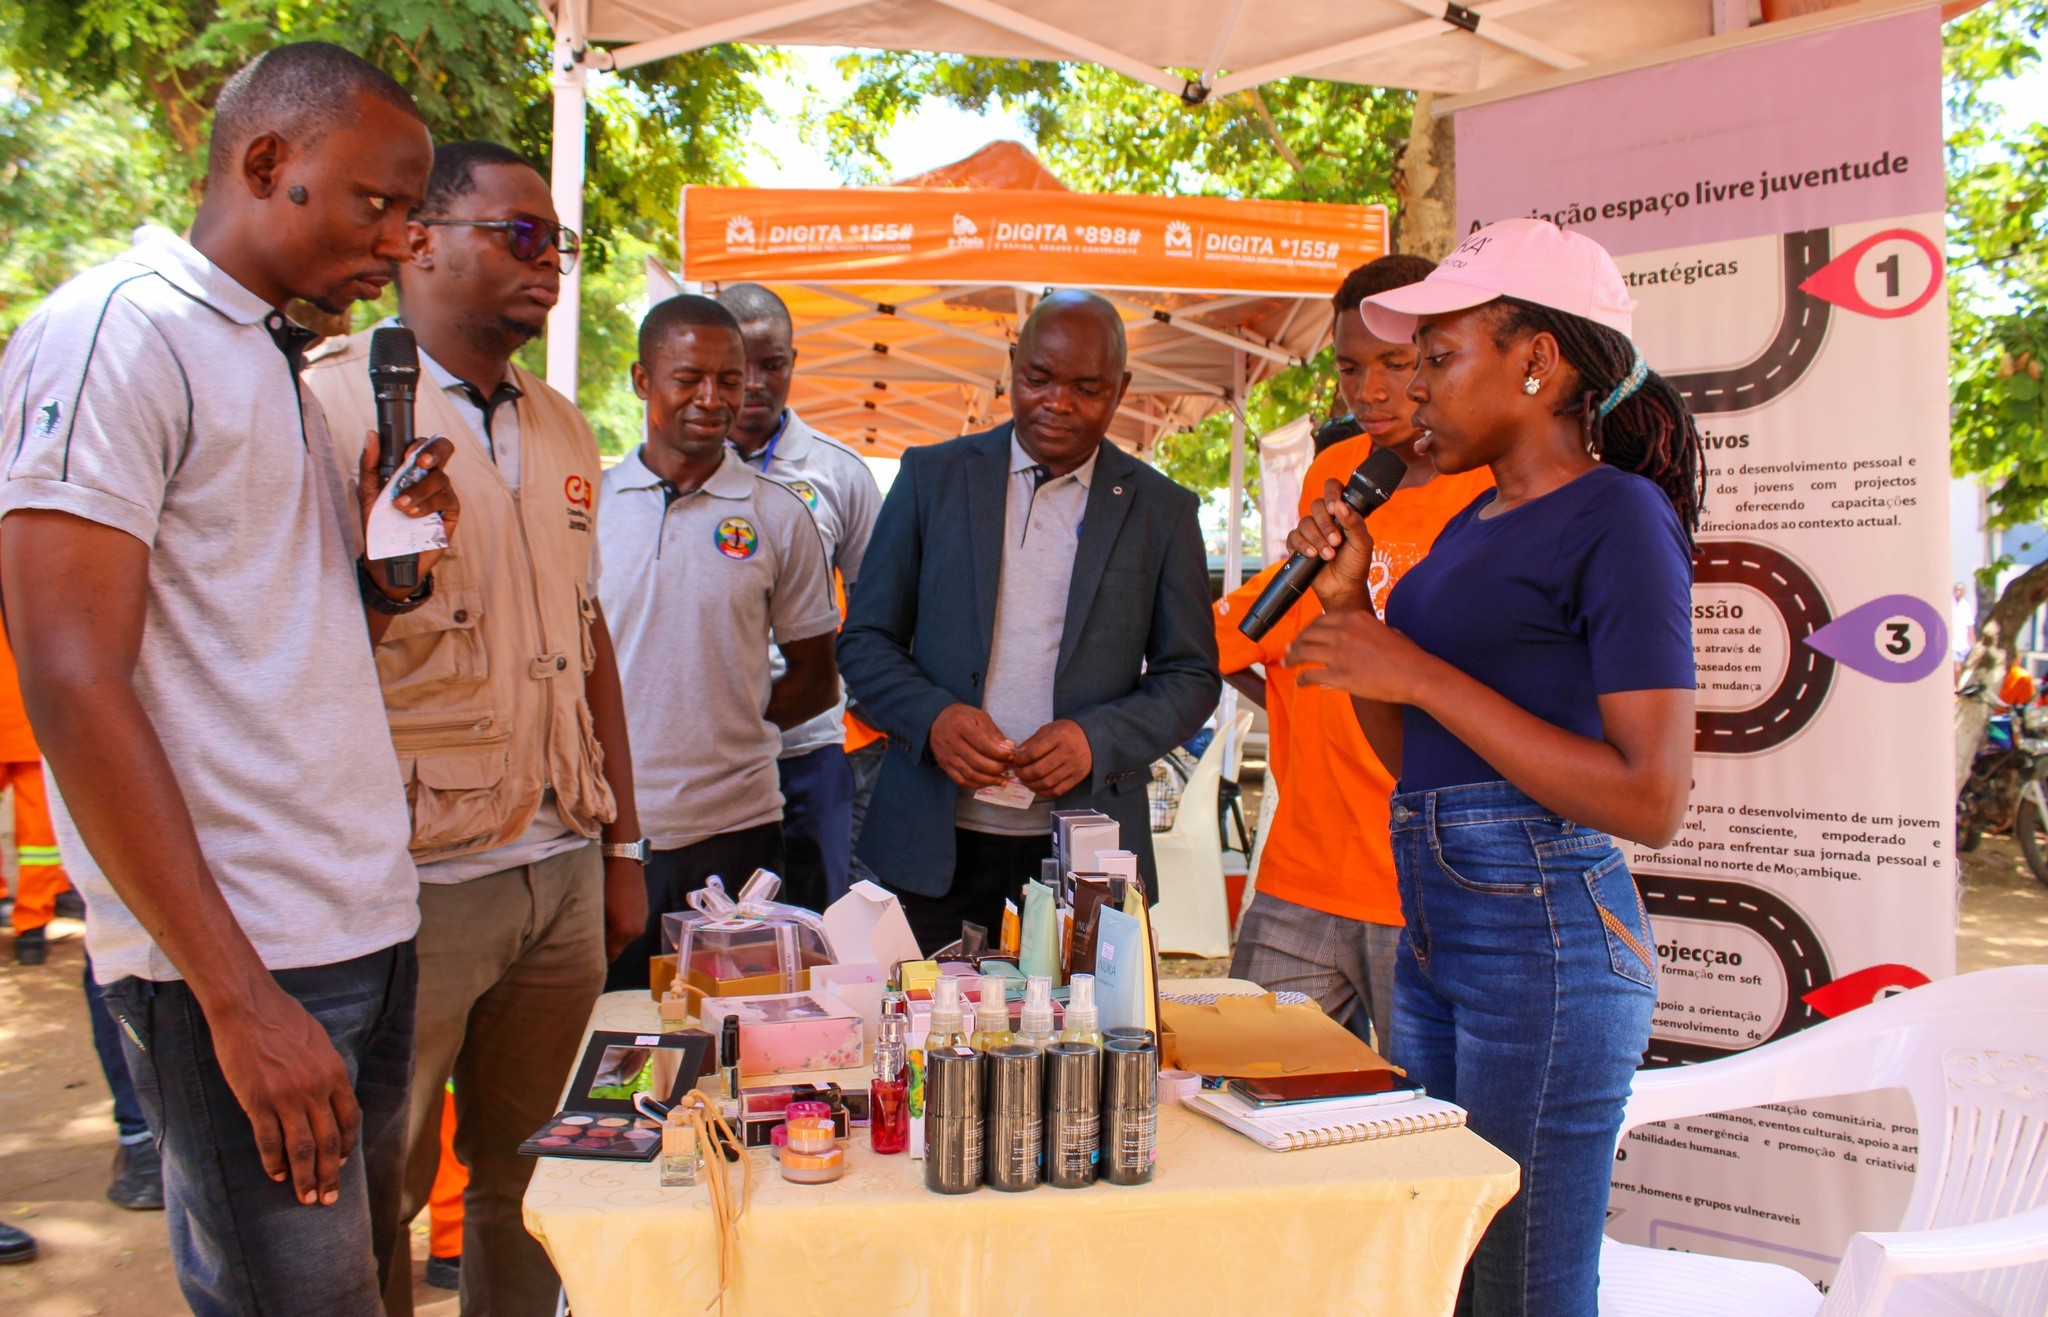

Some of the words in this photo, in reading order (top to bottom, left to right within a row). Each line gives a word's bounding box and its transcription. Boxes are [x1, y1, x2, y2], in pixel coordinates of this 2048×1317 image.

[1602, 191, 1690, 220] espaço
[1696, 178, 1755, 205] livre
[1759, 150, 1909, 200] juventude
[769, 226, 843, 243] DIGITA
[997, 224, 1068, 241] DIGITA
[1206, 233, 1274, 255] DIGITA
[1622, 259, 1738, 287] stratégicas
[1876, 254, 1900, 298] 1
[1699, 430, 1750, 450] tivos
[1727, 467, 1735, 475] o
[1739, 461, 1847, 475] desenvolvimento
[1853, 456, 1902, 471] pessoal
[1908, 457, 1917, 467] e
[1717, 483, 1738, 494] dos
[1753, 482, 1794, 495] jovens
[1810, 481, 1837, 490] com
[1855, 476, 1917, 490] projectos
[1736, 500, 1805, 513] oferecendo
[1831, 496, 1917, 510] capacitações
[1701, 519, 1779, 532] direcionados
[1781, 520, 1796, 529] ao
[1798, 518, 1854, 529] contexto
[1857, 515, 1901, 527] actual.
[1690, 600, 1743, 619] issão
[1697, 627, 1719, 635] uma
[1722, 627, 1745, 635] casa
[1748, 625, 1762, 635] de
[1885, 623, 1911, 655] 3
[1705, 644, 1744, 654] através
[1748, 644, 1762, 653] de
[1695, 662, 1742, 672] baseados
[1745, 664, 1762, 672] em
[1712, 681, 1762, 692] mudança
[1697, 804, 1724, 814] para
[1728, 807, 1736, 815] o
[1739, 804, 1848, 823] desenvolvimento
[1851, 812, 1867, 824] de
[1871, 815, 1893, 826] um
[1897, 815, 1940, 829] jovem
[1729, 823, 1798, 838] consciente,
[1821, 830, 1906, 846] empoderado
[1932, 838, 1941, 848] e
[1698, 841, 1725, 851] para
[1729, 842, 1789, 857] enfrentar
[1794, 848, 1816, 859] sua
[1819, 848, 1871, 863] jornada
[1876, 855, 1927, 868] pessoal
[1932, 858, 1941, 868] e
[1633, 852, 1701, 867] profissional
[1704, 860, 1719, 868] no
[1721, 861, 1754, 872] norte
[1756, 861, 1771, 873] de
[1774, 863, 1861, 882] Moçambique.
[1654, 939, 1743, 968] ojecçao
[1661, 964, 1714, 980] formação
[1718, 973, 1736, 982] em
[1740, 975, 1762, 986] soft
[1655, 1001, 1684, 1012] apoio
[1688, 1005, 1695, 1013] a
[1699, 1006, 1762, 1022] orientação
[1652, 1018, 1739, 1037] esenvolvimento
[1747, 1030, 1762, 1040] de
[1812, 1109, 1886, 1131] comunitária,
[1629, 1130, 1688, 1149] habilidades
[1689, 1141, 1740, 1159] humanas.
[1758, 1119, 1802, 1134] eventos
[1803, 1127, 1855, 1144] culturais,
[1857, 1137, 1890, 1150] apoio
[1892, 1143, 1899, 1151] a
[1674, 1122, 1681, 1130] a
[1686, 1125, 1749, 1142] emergência
[1764, 1139, 1771, 1147] e
[1778, 1141, 1836, 1158] promoção
[1843, 1151, 1858, 1163] da
[1865, 1157, 1917, 1173] criativid
[1611, 1181, 1636, 1192] eres
[1685, 1195, 1692, 1203] e
[1694, 1196, 1732, 1211] grupos
[1733, 1205, 1801, 1226] vulneraveis
